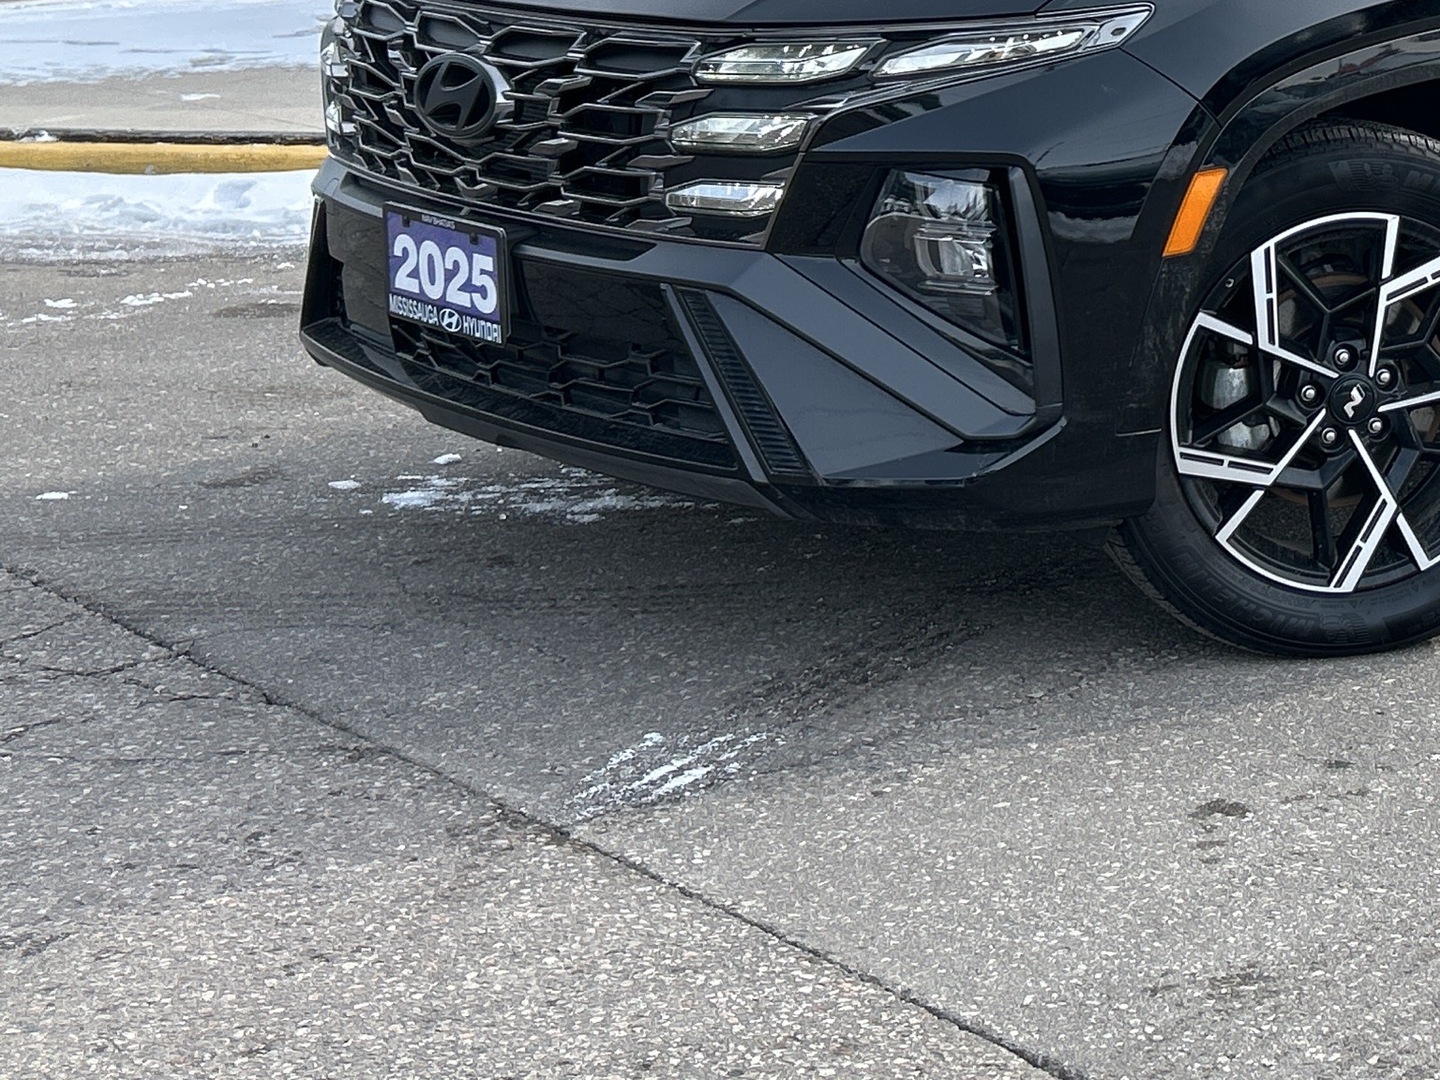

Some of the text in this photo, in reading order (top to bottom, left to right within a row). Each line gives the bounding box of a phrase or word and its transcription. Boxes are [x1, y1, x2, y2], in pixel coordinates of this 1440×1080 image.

[393, 233, 497, 314] 2025
[389, 293, 502, 344] MISSISSAUGA HYUNDAI
